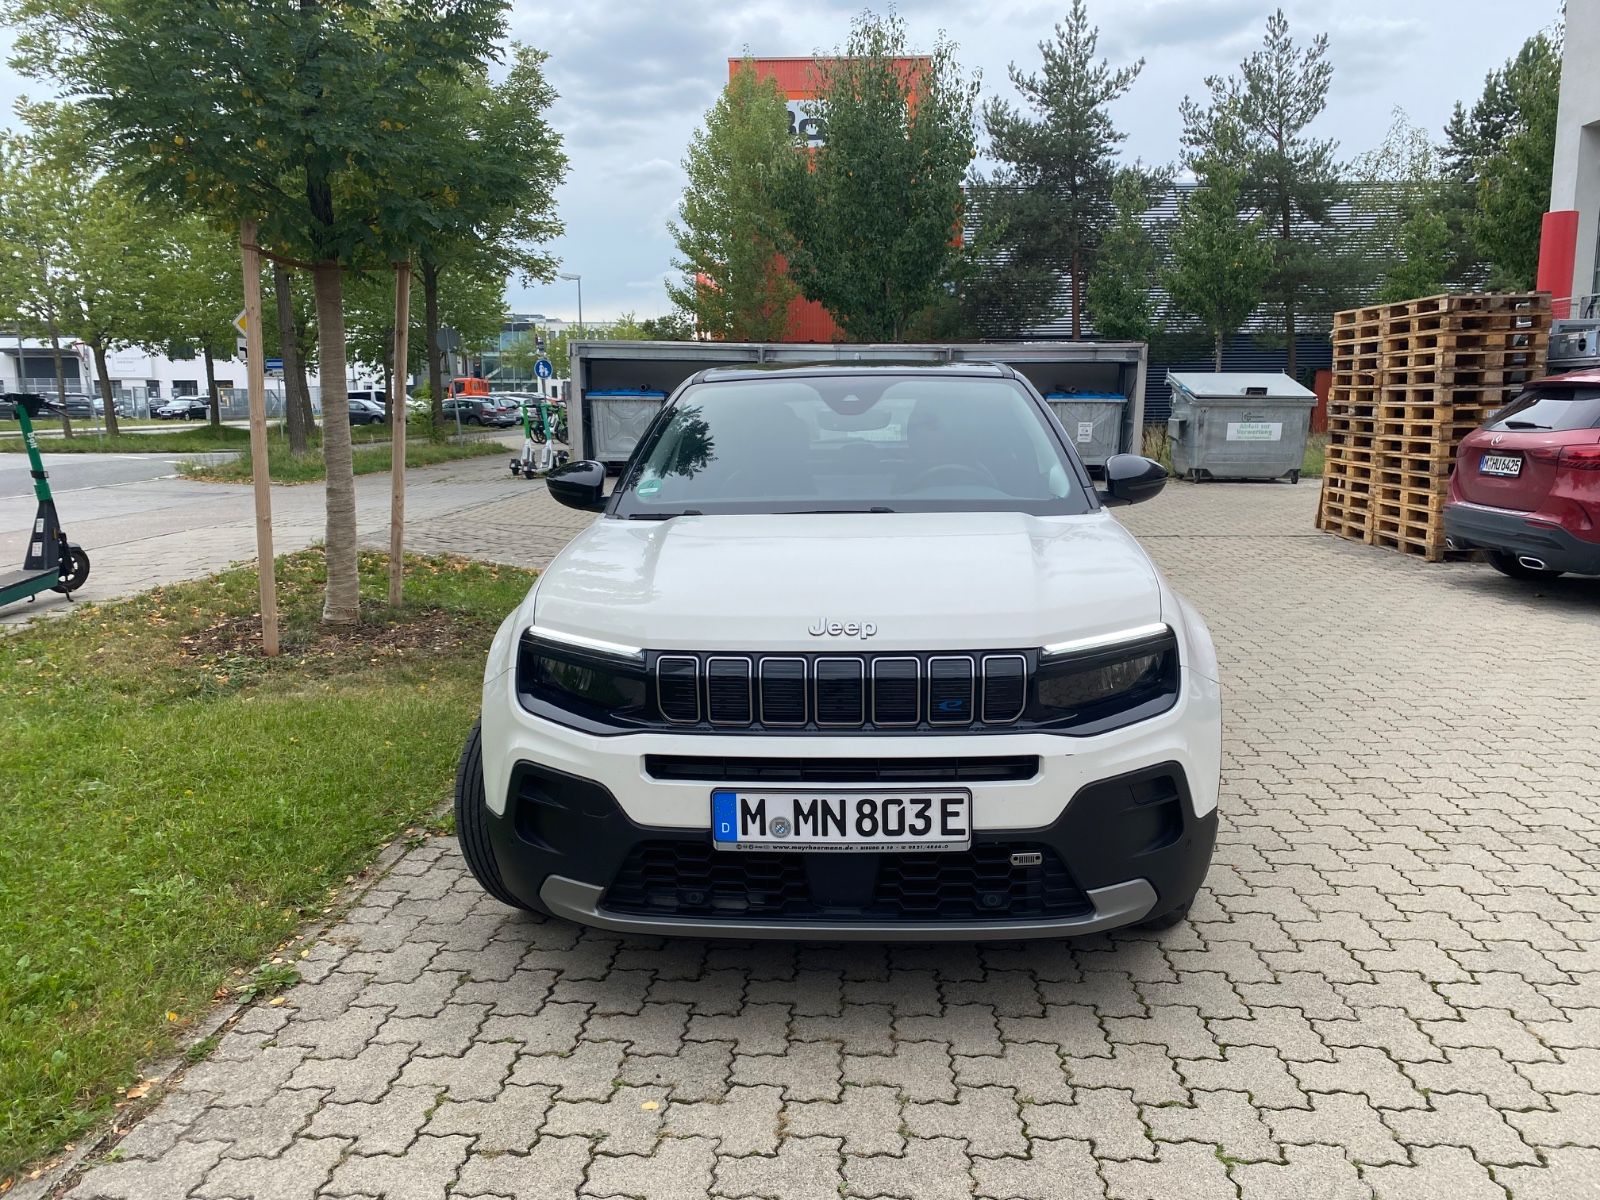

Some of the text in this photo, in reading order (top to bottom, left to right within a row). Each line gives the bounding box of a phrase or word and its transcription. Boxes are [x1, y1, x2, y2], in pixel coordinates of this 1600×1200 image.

[808, 616, 877, 640] Jeep
[721, 822, 730, 833] D
[740, 798, 766, 836] M
[793, 798, 846, 836] MN
